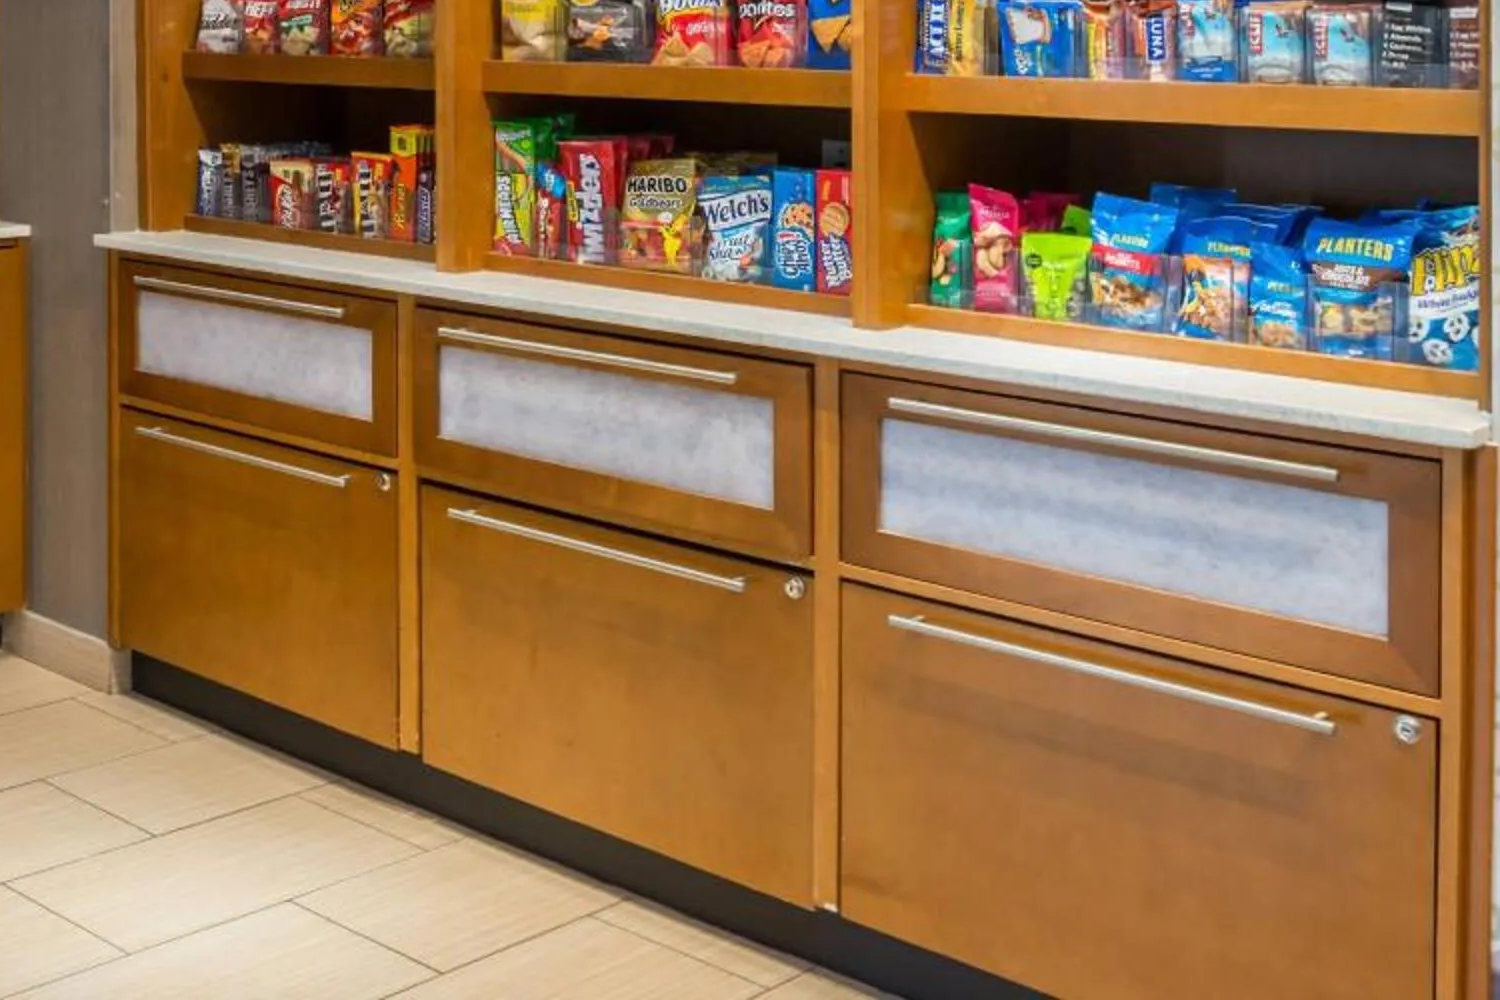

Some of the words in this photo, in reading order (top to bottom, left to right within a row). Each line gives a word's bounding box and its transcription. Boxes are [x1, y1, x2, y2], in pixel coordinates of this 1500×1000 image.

[739, 2, 796, 19] Doritos
[929, 27, 946, 59] ACT
[627, 177, 687, 193] HARIBO
[498, 175, 522, 245] AIRHEADS
[576, 153, 604, 264] Twizzlers
[702, 194, 769, 224] Welch's
[782, 240, 798, 277] Chips
[1316, 236, 1395, 263] PLANTERS
